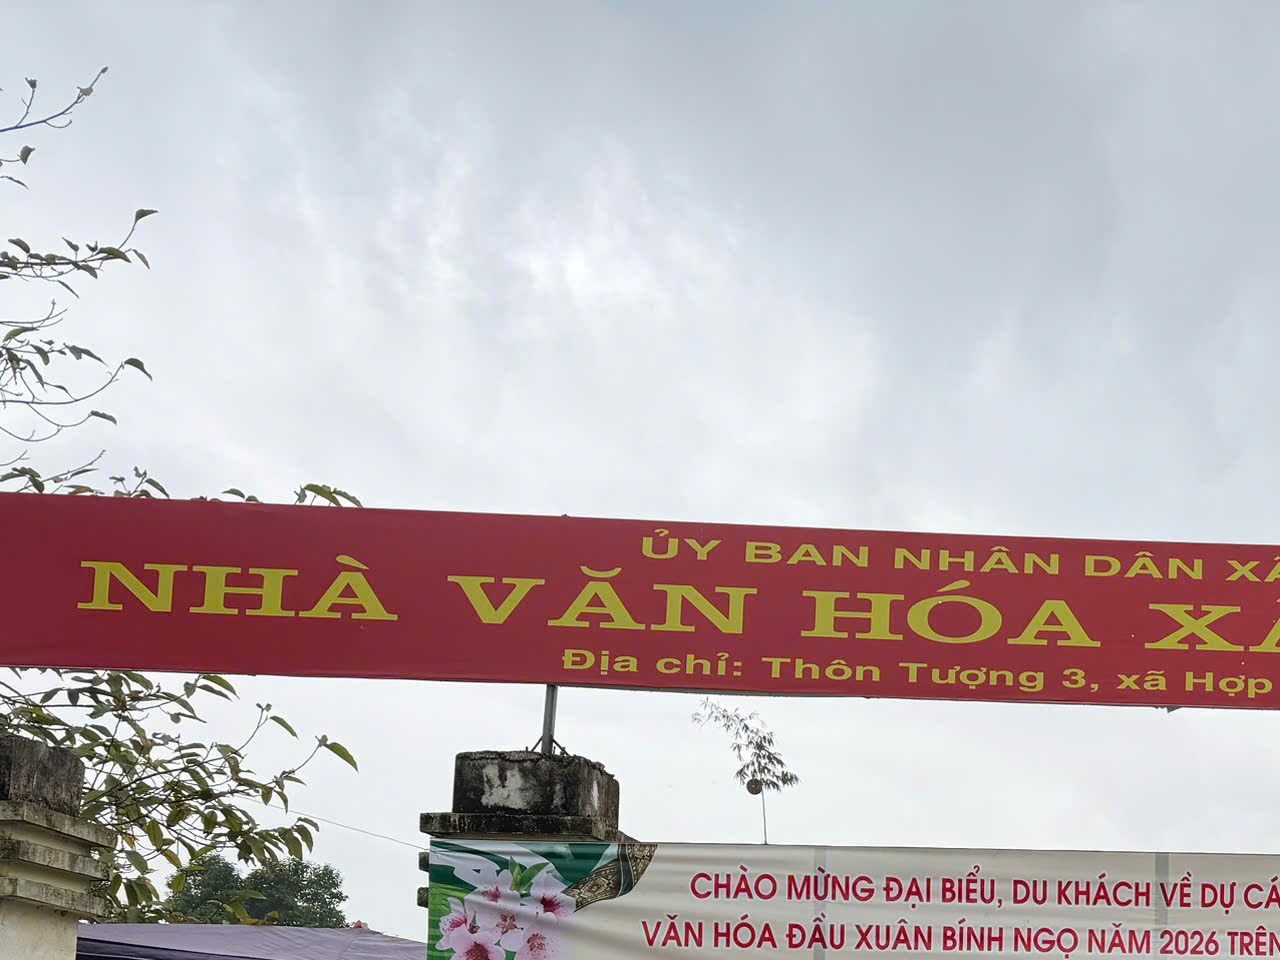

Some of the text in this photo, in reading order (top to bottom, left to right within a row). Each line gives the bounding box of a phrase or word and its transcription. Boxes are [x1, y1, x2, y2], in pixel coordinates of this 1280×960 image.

[642, 529, 721, 561] ỦY
[744, 541, 869, 568] BAN
[895, 546, 1060, 575] NHÂN
[1084, 551, 1203, 580] DÂN
[77, 555, 398, 621] NHÀ
[447, 565, 758, 634] VĂN
[801, 579, 1101, 648] HÓA
[563, 648, 638, 676] Địa
[656, 651, 742, 677] chỉ:
[763, 656, 881, 681] Thôn
[900, 662, 1045, 692] Tượng
[1063, 668, 1099, 692] 3,
[1118, 669, 1167, 691] xã
[1185, 671, 1273, 699] Hợp
[690, 864, 777, 900] CHÀO
[787, 866, 875, 902] MỪNG
[883, 876, 932, 909] ĐẠI
[941, 865, 1003, 908] BIỂU,
[1012, 879, 1048, 905] DU
[1057, 872, 1151, 907] KHÁCH
[1160, 872, 1192, 908] VỀ
[1201, 882, 1236, 915] DỰ
[642, 914, 703, 948] VĂN
[713, 914, 777, 949] HÓA
[786, 913, 845, 951] ĐẦU
[855, 919, 933, 951] XUÂN
[942, 918, 1005, 952] BÍNH
[1014, 927, 1079, 959] NGỌ
[1087, 922, 1151, 954] NĂM
[1160, 930, 1220, 956] 2026
